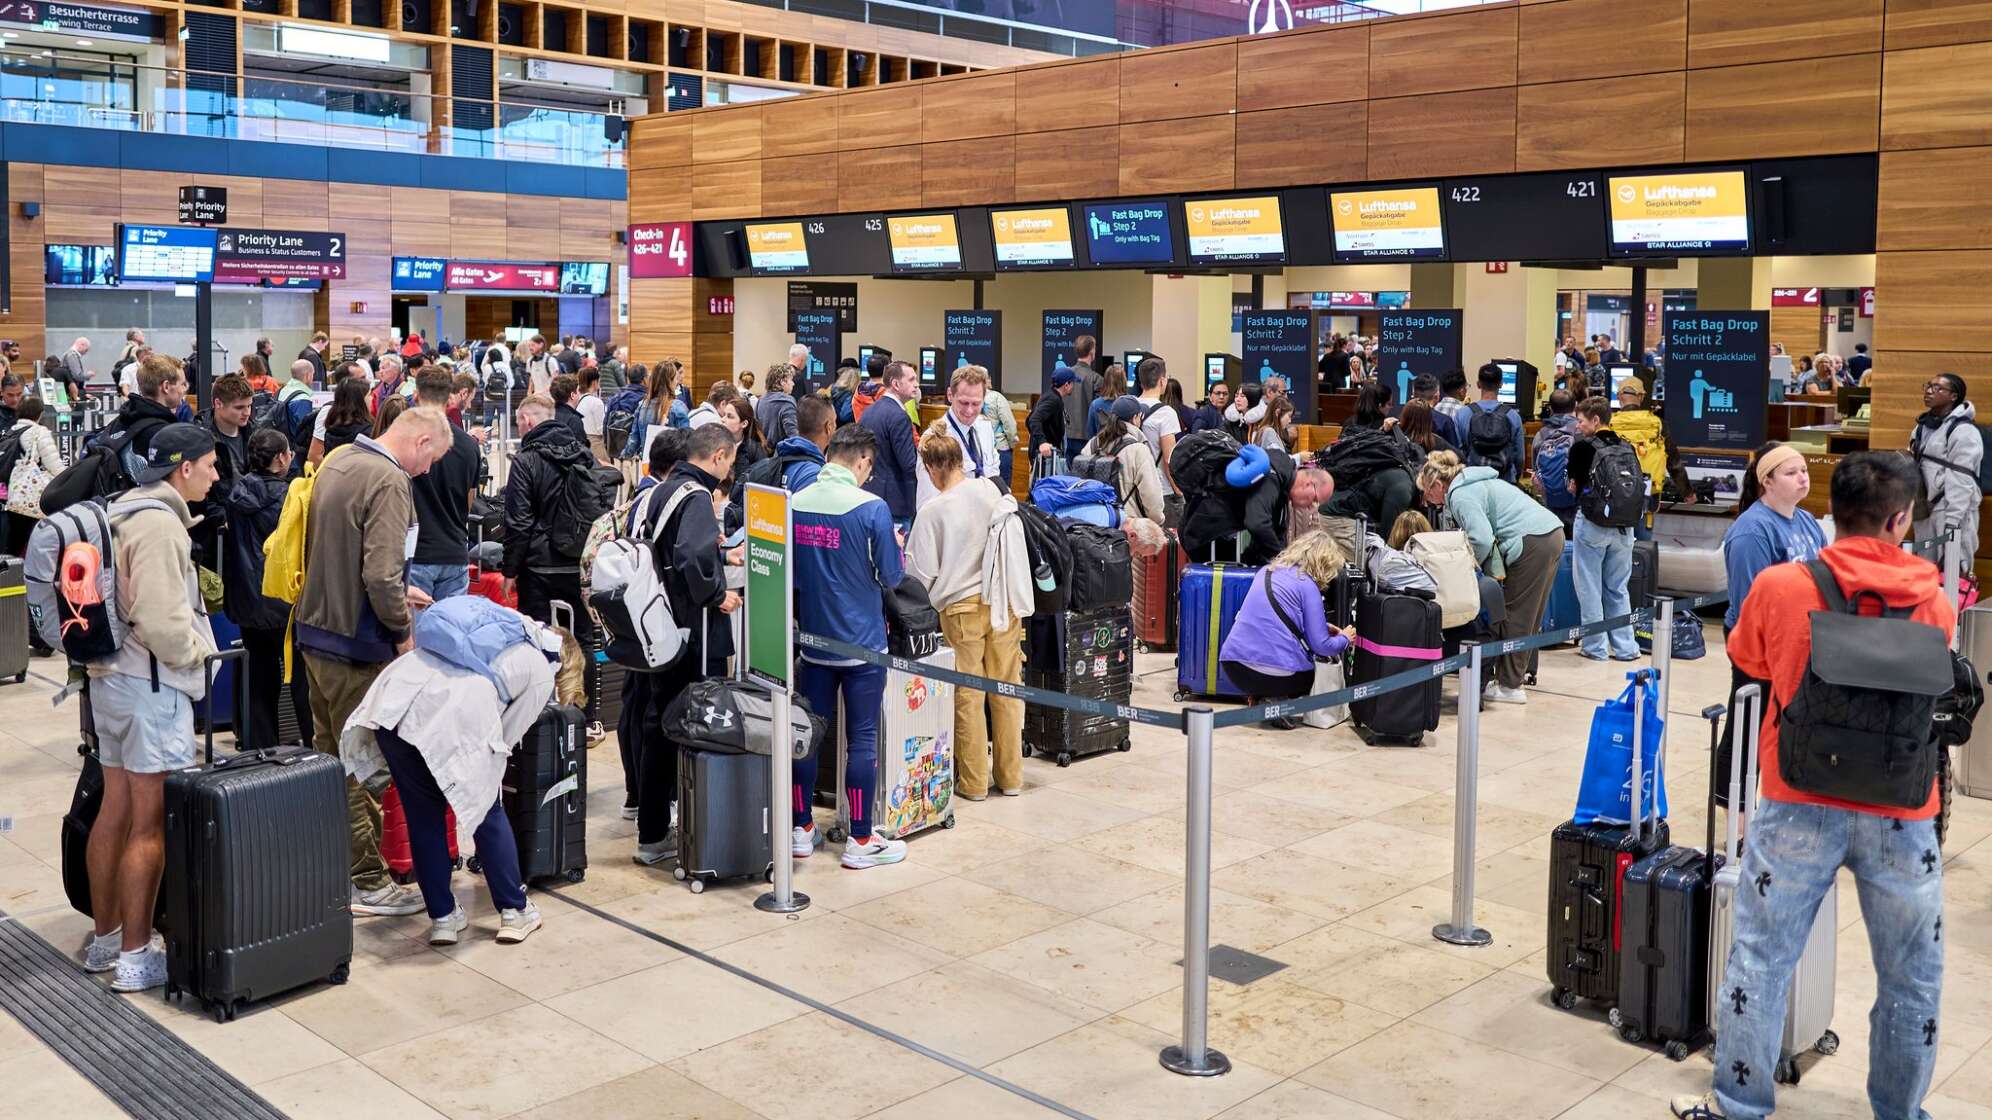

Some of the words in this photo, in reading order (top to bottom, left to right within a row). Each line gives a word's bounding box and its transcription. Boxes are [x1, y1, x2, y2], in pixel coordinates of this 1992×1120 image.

[50, 5, 139, 24] Besucherterrasse
[83, 21, 112, 31] Terrace
[1451, 187, 1481, 202] 422
[1566, 181, 1595, 197] 421
[1644, 186, 1717, 199] Lufthansa
[195, 202, 226, 213] Priority
[1359, 200, 1417, 211] Lufthansa
[195, 211, 214, 220] Lane
[1112, 211, 1127, 220] Fast
[1129, 210, 1143, 221] Bag
[1145, 210, 1163, 220] Drop
[1210, 209, 1261, 219] Lufthansa
[808, 222, 825, 234] 426
[865, 219, 882, 231] 425
[906, 223, 942, 233] Lufthansa
[1012, 218, 1053, 228] Lufthansa
[1113, 222, 1129, 231] Step
[1131, 222, 1137, 230] 2
[143, 229, 168, 239] Priority
[633, 228, 664, 241] Check-in
[1140, 235, 1150, 243] Bag
[1151, 235, 1160, 243] Tag
[142, 236, 158, 244] Lane
[238, 234, 277, 247] Priority
[279, 235, 303, 247] Lane
[238, 246, 265, 255] Business
[271, 247, 290, 256] Status
[290, 249, 321, 257] Customers
[329, 238, 342, 257] 2
[668, 227, 688, 267] 4
[414, 261, 443, 273] Priority
[451, 267, 464, 276] Alle
[465, 268, 484, 277] Gates
[414, 269, 432, 279] Lane
[810, 315, 820, 324] Bag
[821, 315, 833, 324] Drop
[948, 316, 961, 324] Fast
[962, 316, 975, 326] Bag
[977, 316, 992, 326] Drop
[1045, 316, 1059, 324] Fast
[1061, 316, 1075, 326] Bag
[1076, 316, 1092, 326] Drop
[1247, 317, 1265, 327] Fast
[1267, 316, 1284, 329] Bag
[1286, 316, 1308, 329] Drop
[1383, 317, 1401, 327] Fast
[1403, 317, 1425, 329] Bag
[1427, 317, 1451, 329] Drop
[948, 327, 969, 335] Schritt
[970, 327, 975, 335] 2
[1672, 320, 1697, 330] Fast
[1701, 320, 1724, 333] Bag
[1728, 320, 1758, 333] Drop
[1045, 328, 1060, 337] Step
[1061, 328, 1066, 336] 2
[1247, 330, 1277, 339] Schritt
[1278, 330, 1283, 339] 2
[1382, 330, 1404, 342] Step
[1406, 330, 1413, 340] 2
[1672, 334, 1712, 345] Schritt
[1715, 335, 1722, 345] 2
[1271, 344, 1306, 353] Gepäcklabel
[1382, 346, 1398, 354] Only
[1414, 346, 1429, 355] Bag
[1431, 346, 1443, 355] Tag
[1672, 352, 1688, 360] Nur
[1690, 352, 1704, 360] mit
[1706, 352, 1756, 362] Gepäcklabel
[750, 516, 784, 536] Lufthansa
[826, 528, 840, 539] 20
[826, 538, 840, 549] 25
[751, 543, 783, 566] Economy
[751, 559, 770, 577] Class
[1629, 614, 1639, 624] BER
[800, 633, 814, 646] BER
[1569, 630, 1580, 640] BER
[1502, 642, 1514, 652] BER
[893, 657, 909, 671] BER
[1433, 662, 1445, 675] BER
[997, 682, 1017, 696] BER
[1353, 685, 1368, 699] BER
[1117, 705, 1138, 720] BER
[1264, 705, 1280, 720] BER
